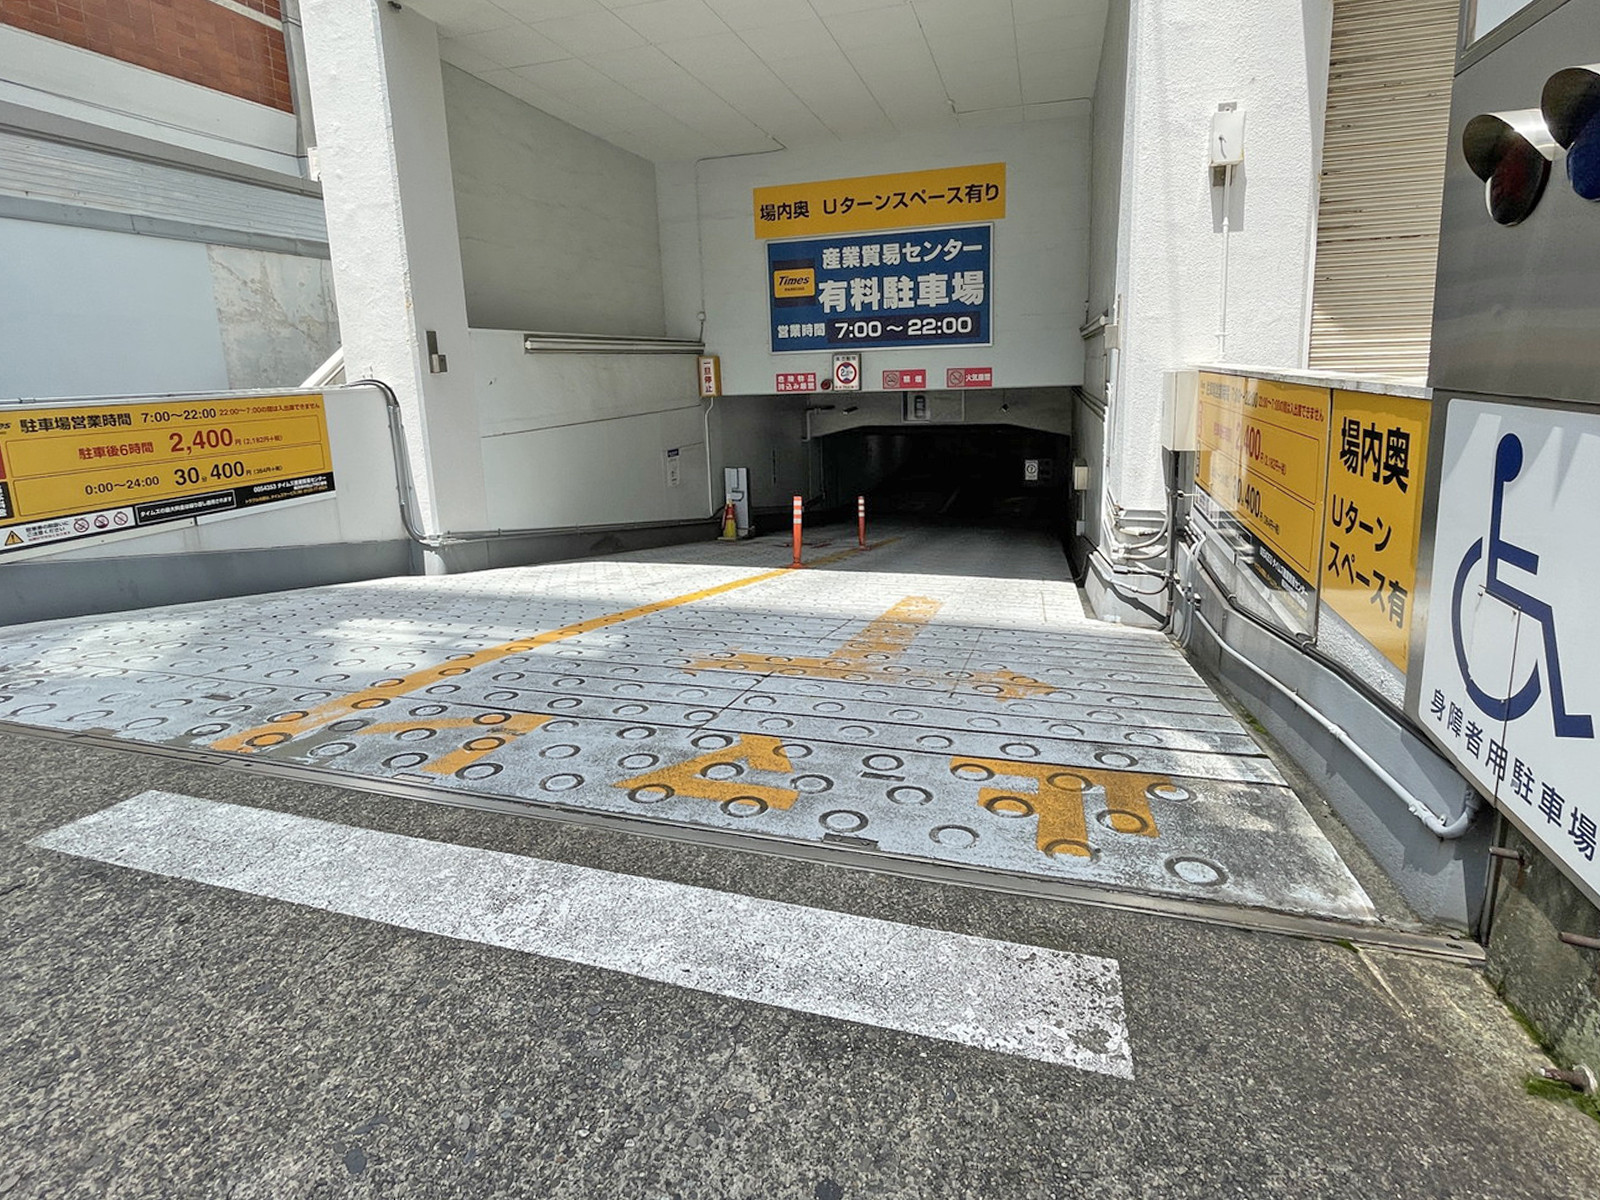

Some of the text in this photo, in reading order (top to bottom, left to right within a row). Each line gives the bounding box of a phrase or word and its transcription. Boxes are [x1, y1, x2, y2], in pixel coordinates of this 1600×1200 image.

[760, 183, 1000, 222] 場内奥 Uターンスペース有り
[822, 238, 983, 270] 産業貿易センター
[779, 276, 809, 286] Times
[818, 270, 985, 313] 有料駐車場
[777, 323, 826, 339] 営業時間
[20, 412, 132, 433] 駐車場営業時間
[141, 408, 217, 424] 7:00〜22:00
[78, 441, 154, 461] 駐車後6時間
[1339, 416, 1410, 494] 場内奥
[85, 475, 160, 496] 0:00〜24:00
[1331, 494, 1392, 552] Uターン
[1430, 688, 1598, 863] 身障者用駐車場
